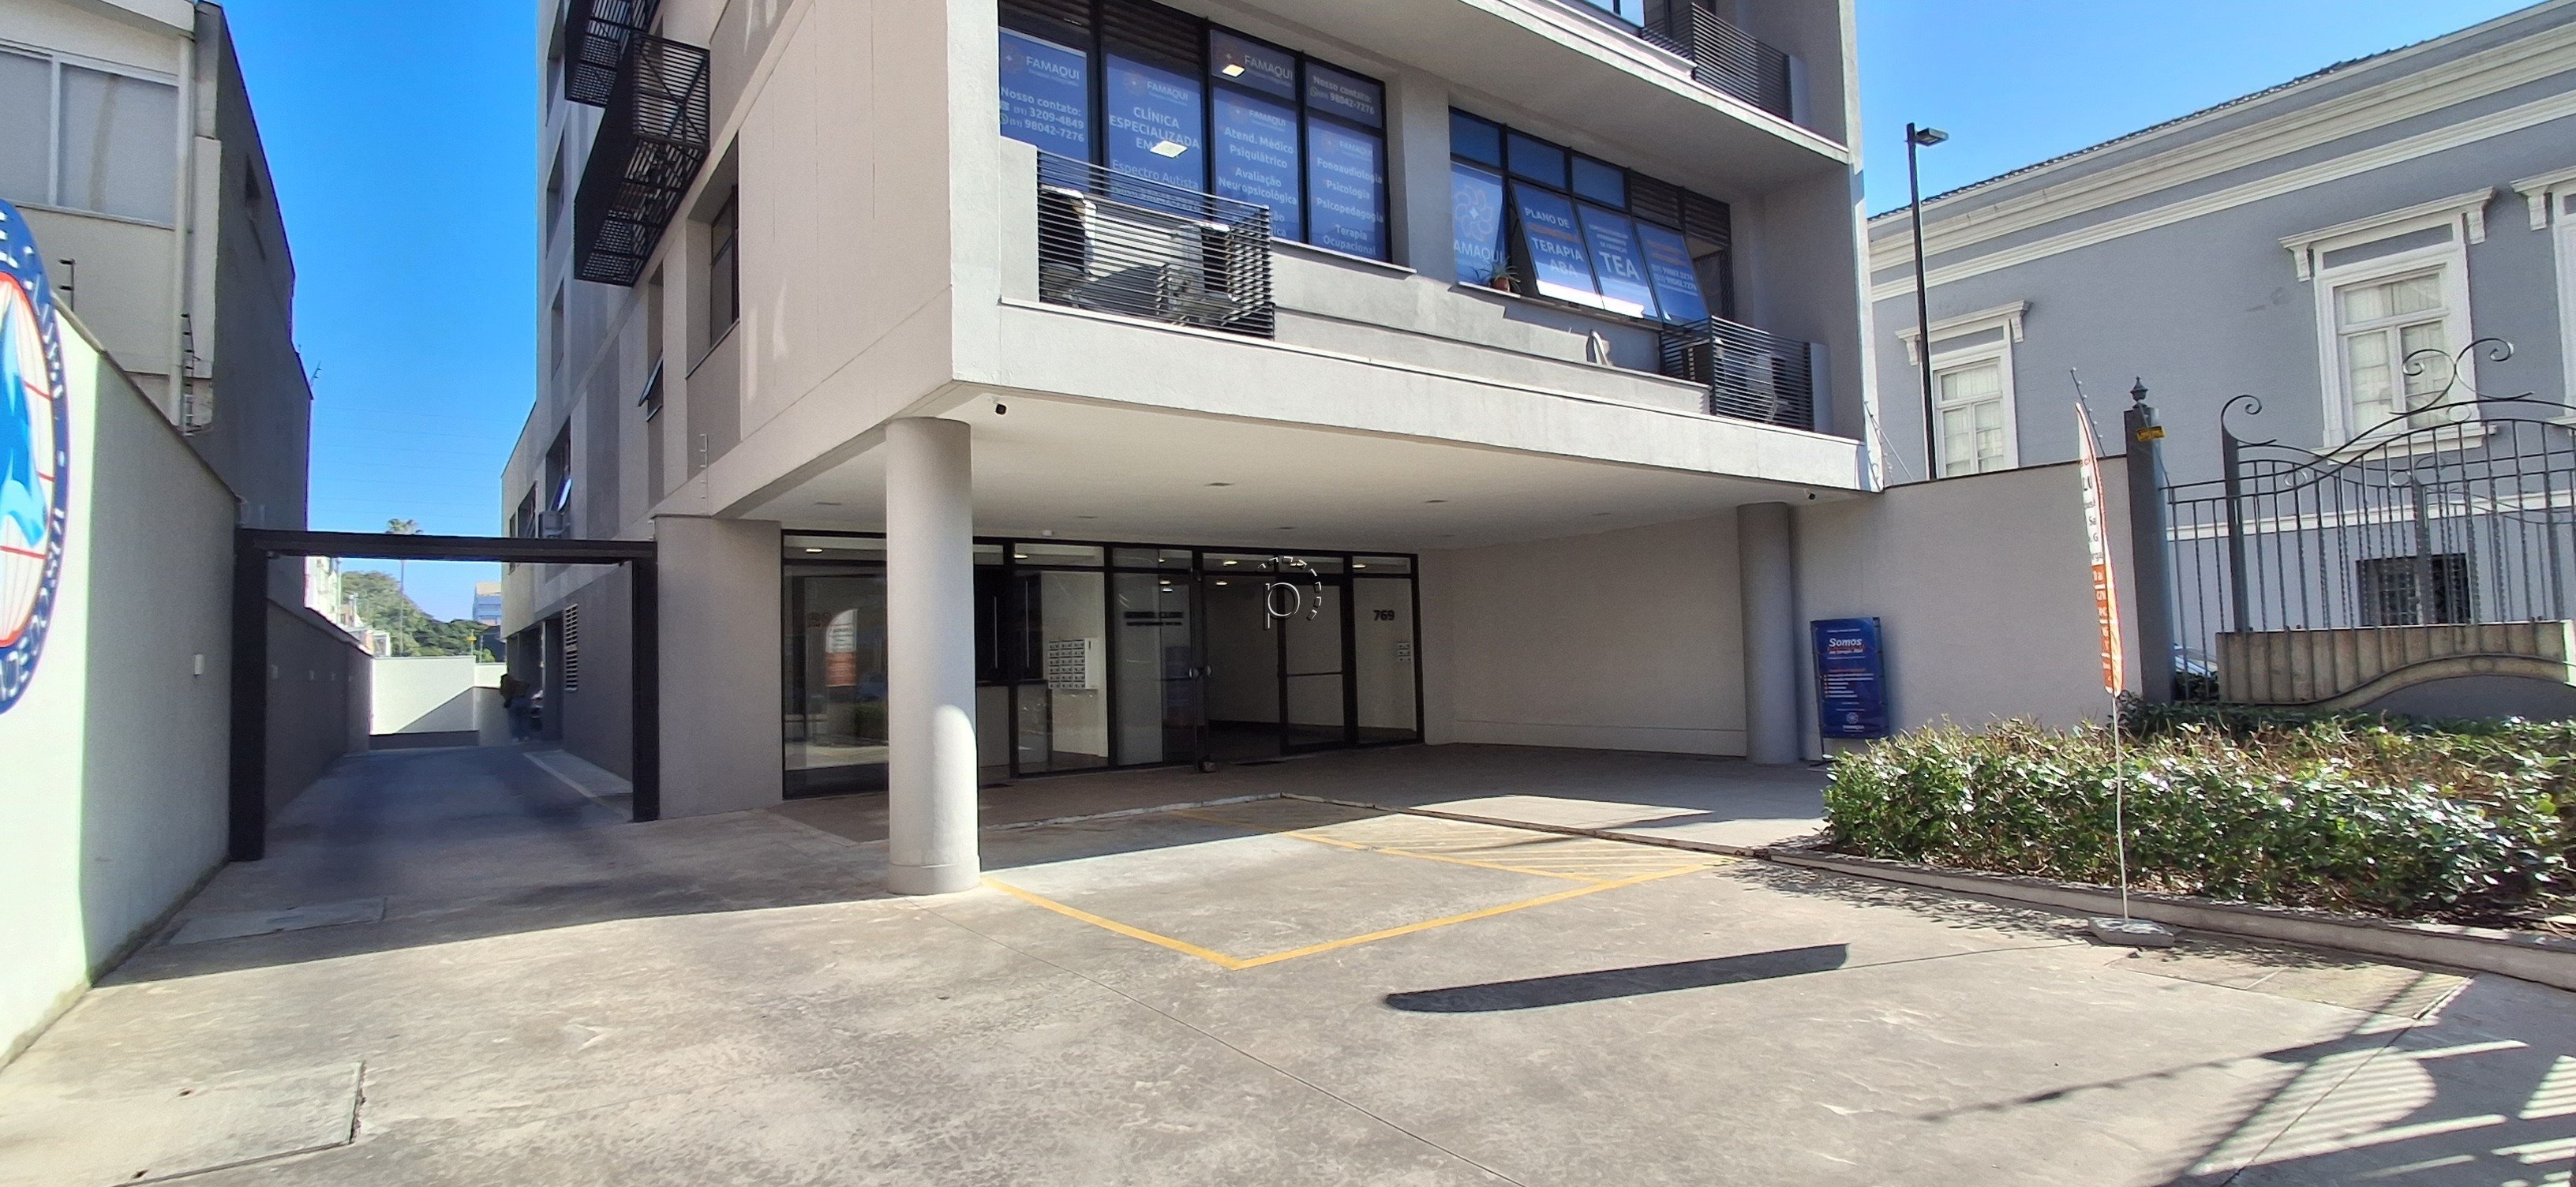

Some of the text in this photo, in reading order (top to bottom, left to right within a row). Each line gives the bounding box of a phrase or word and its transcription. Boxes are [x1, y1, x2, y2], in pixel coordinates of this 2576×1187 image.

[1026, 55, 1080, 80] FAMAQUI
[1244, 54, 1293, 81] FAMAQUI
[1146, 81, 1189, 101] FAMAQUI
[1313, 76, 1339, 92] Nosso
[1001, 86, 1082, 117] Nosso contato:
[1029, 107, 1084, 129] 3209-4849
[1133, 105, 1180, 129] CLÍNICA
[1024, 119, 1085, 142] 98042-7276
[1110, 114, 1200, 150] ESPECIALIZADA
[1224, 126, 1294, 155] Atend. Médico
[1230, 144, 1288, 169] Psiquiátrico
[1112, 159, 1200, 191] Espectro Autista
[1235, 167, 1282, 188] Avaliação
[1316, 157, 1383, 184] Fonoaudiologia
[1219, 176, 1297, 205] Neuropsicológica
[1326, 179, 1370, 200] Psicologia
[1316, 197, 1384, 223] Psicopedagogia
[1524, 207, 1571, 230] PLANO DE
[1334, 224, 1368, 241] Terapia
[1323, 235, 1376, 255] Ocupacional
[1454, 239, 1503, 264] AMAQUI
[1531, 237, 1584, 262] TERAPIA
[1549, 258, 1578, 277] ABA
[1598, 250, 1641, 281] TEA
[1372, 610, 1395, 622] 769
[1829, 638, 1863, 647] Somos
